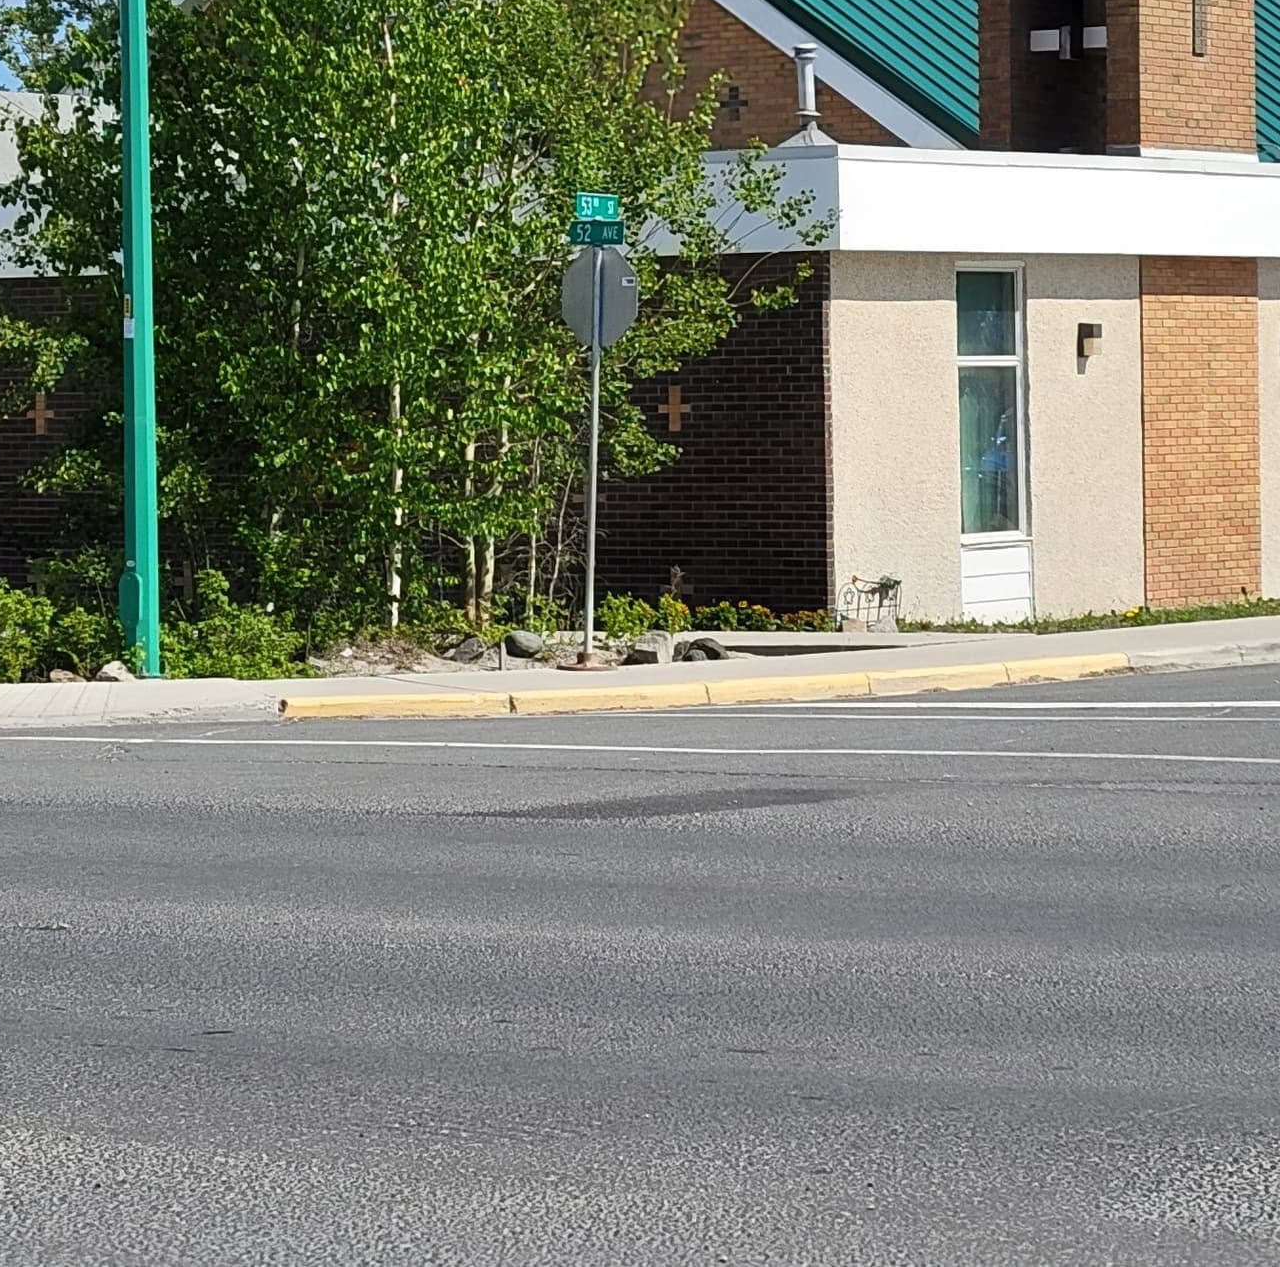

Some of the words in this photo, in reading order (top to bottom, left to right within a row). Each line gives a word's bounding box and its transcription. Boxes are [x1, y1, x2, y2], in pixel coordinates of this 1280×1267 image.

[607, 201, 614, 214] ST
[577, 224, 591, 242] 52
[602, 226, 618, 240] AVE
